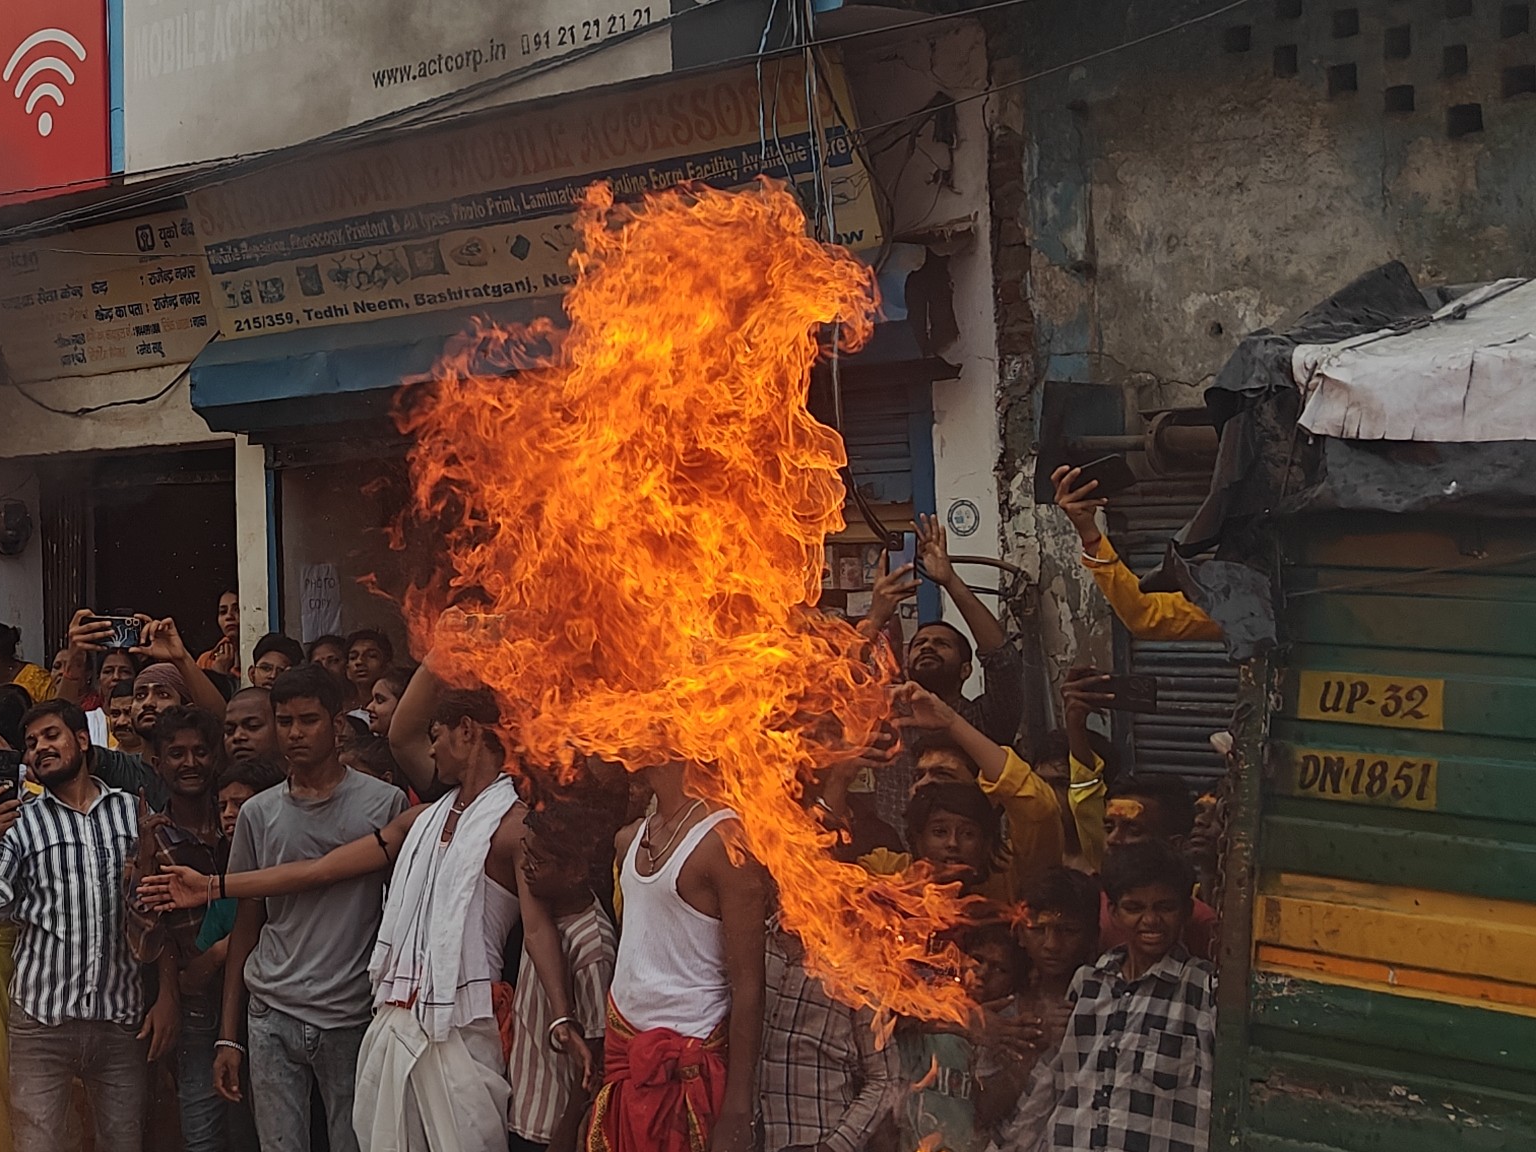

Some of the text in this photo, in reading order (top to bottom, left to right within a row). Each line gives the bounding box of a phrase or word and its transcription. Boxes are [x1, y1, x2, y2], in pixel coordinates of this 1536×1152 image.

[372, 38, 506, 88] www.actcorp.in
[558, 26, 576, 46] 21
[582, 18, 601, 41] 21
[607, 14, 626, 36] 21
[633, 6, 652, 29] 21
[447, 122, 575, 190] MOBILE
[345, 215, 390, 241] Printout
[452, 200, 486, 224] Photo
[649, 167, 685, 193] Form
[686, 154, 739, 181] Facility
[174, 265, 196, 281] नगर
[115, 305, 128, 319] का
[128, 303, 144, 317] पता
[179, 291, 201, 306] नगर
[303, 303, 350, 324] Tedhi
[353, 295, 410, 315] Neem,
[415, 276, 539, 308] Bashiratganj,
[305, 577, 336, 590] PHOTO
[309, 598, 331, 610] COPY
[1319, 680, 1431, 720] UP-32
